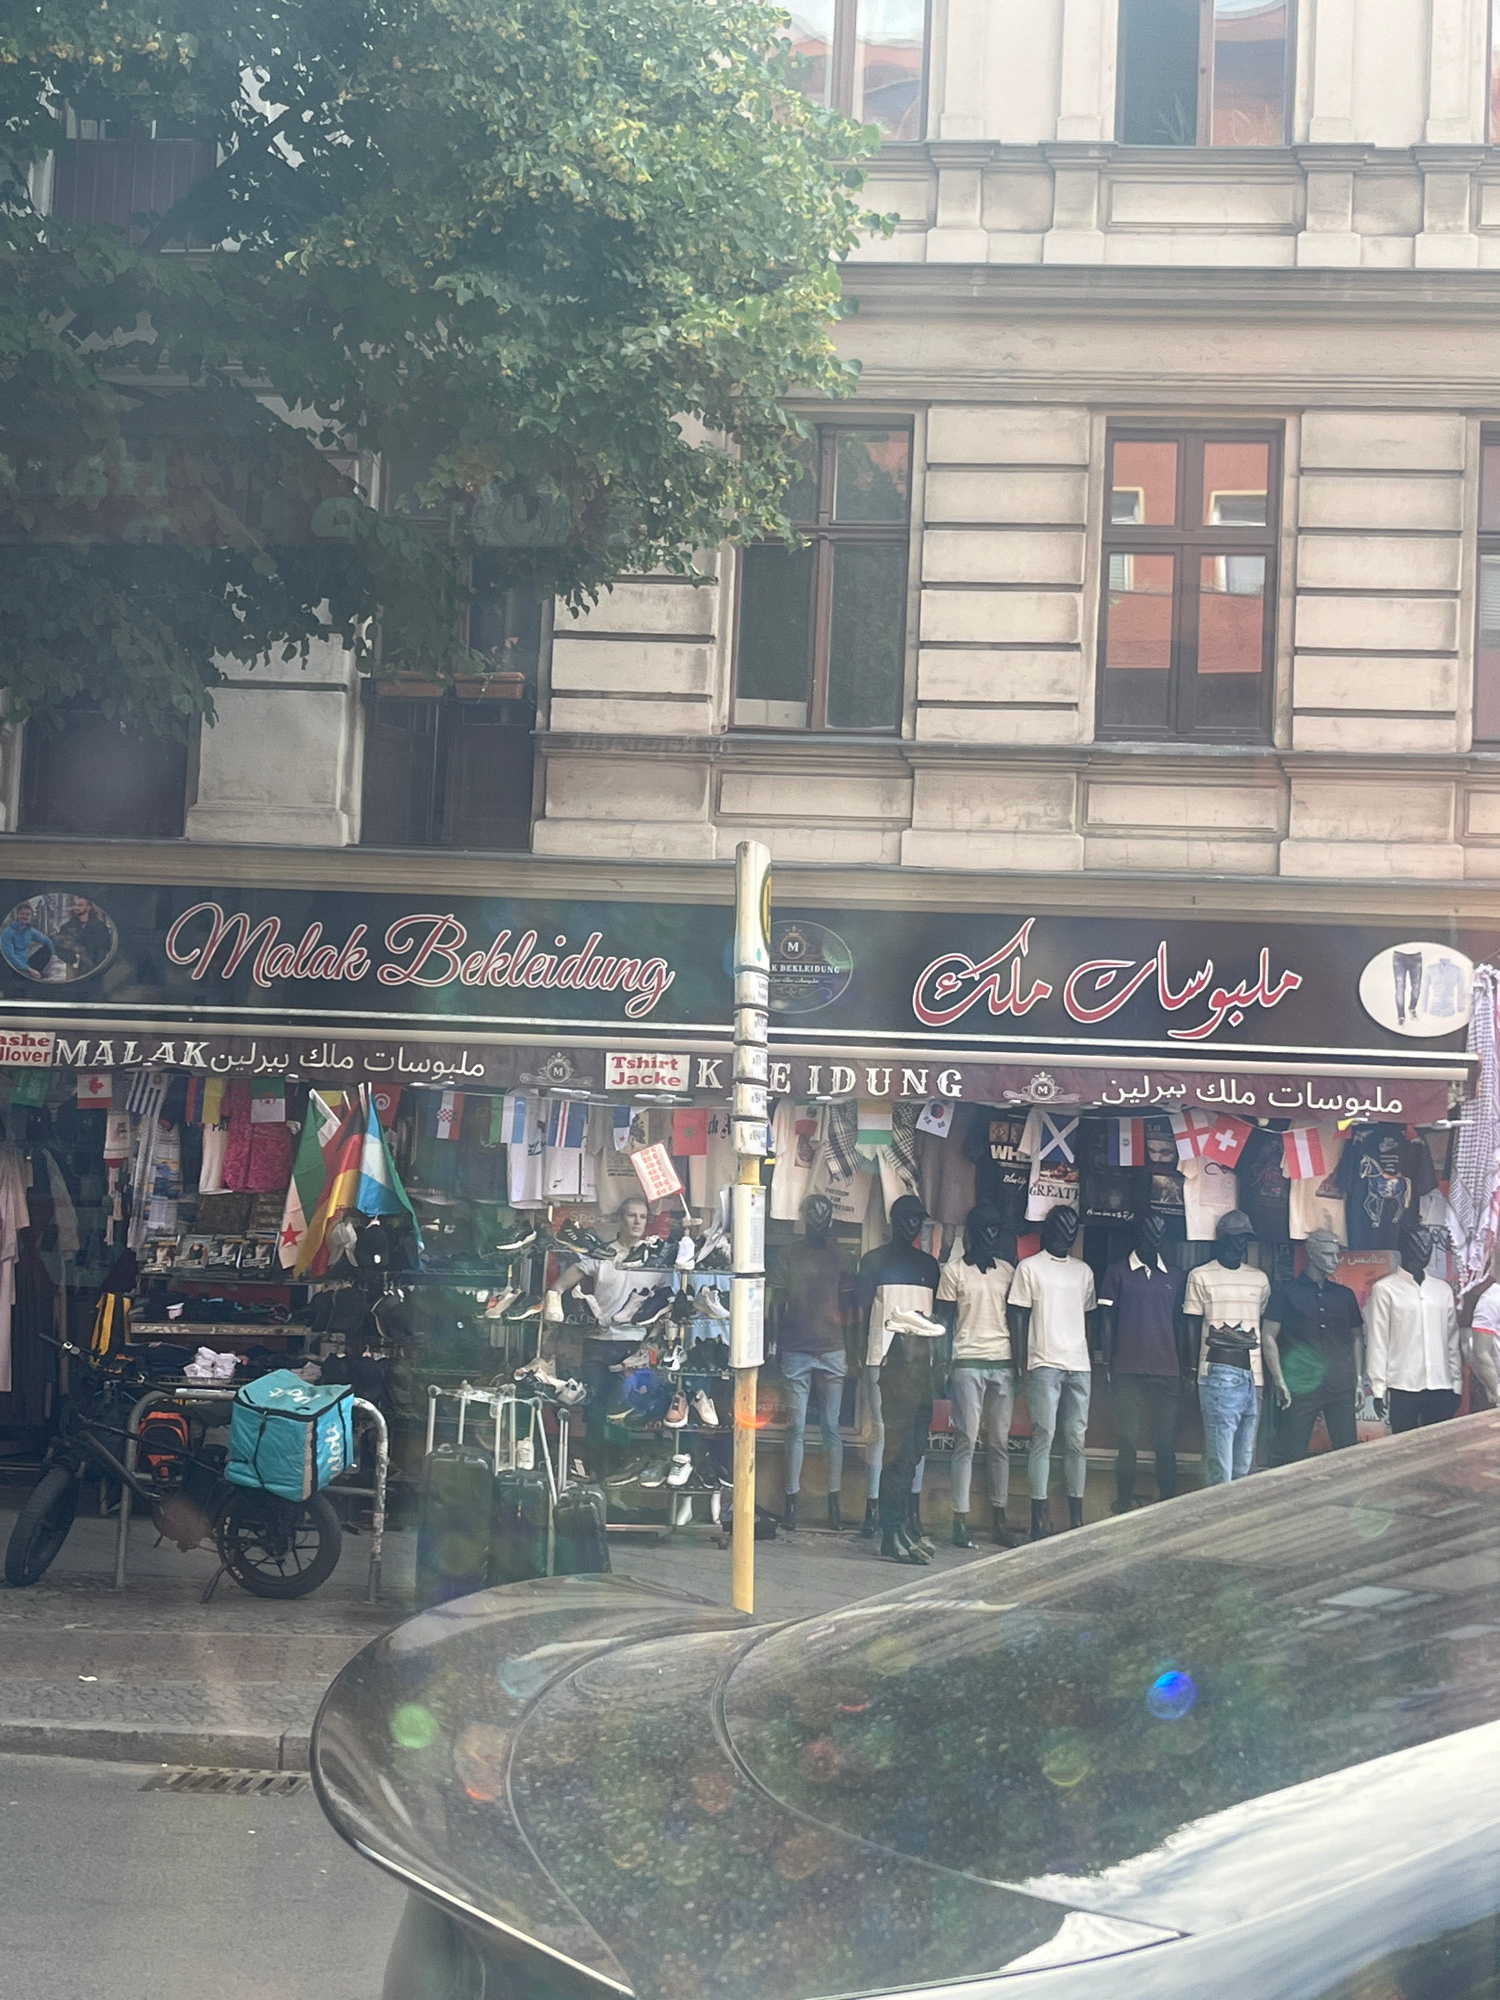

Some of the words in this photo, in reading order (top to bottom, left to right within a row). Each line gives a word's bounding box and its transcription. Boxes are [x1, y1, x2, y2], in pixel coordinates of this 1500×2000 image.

[166, 902, 371, 988] Malak
[376, 913, 676, 1019] Bekleidung
[787, 941, 799, 952] M
[780, 964, 840, 974] BEKLEIDUNG
[912, 917, 1053, 1027] ملك
[1063, 940, 1302, 1040] ملبوسات
[53, 1038, 209, 1068] MALAK
[299, 1043, 354, 1069] ملك
[363, 1046, 486, 1080] ملبوسات
[611, 1056, 678, 1071] Tshirt
[611, 1071, 682, 1087] Jacke
[1196, 1078, 1256, 1106] ملك
[1267, 1081, 1403, 1117] ملبوسات
